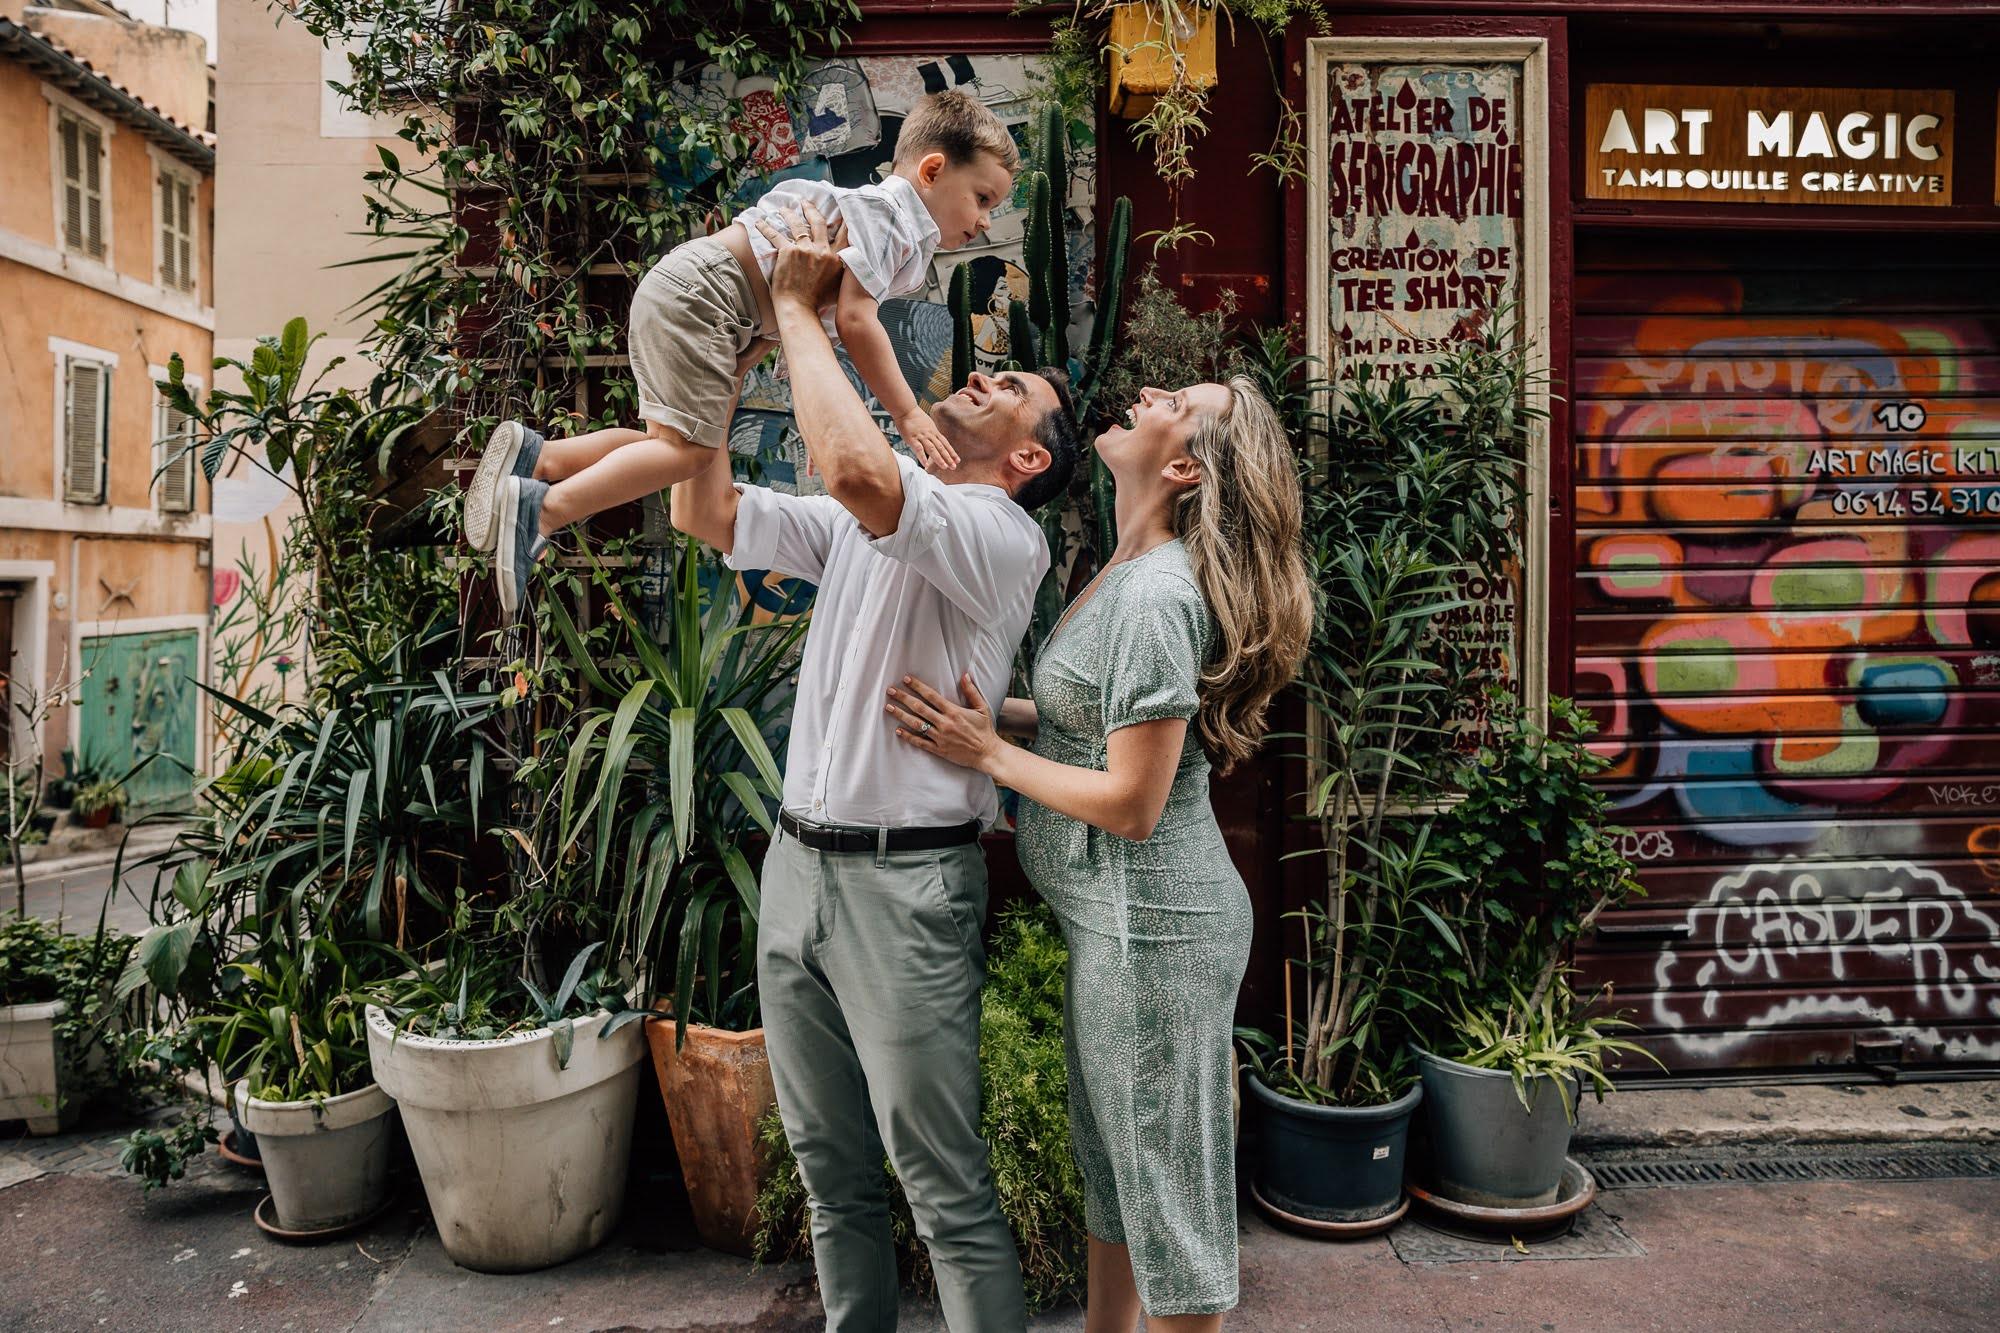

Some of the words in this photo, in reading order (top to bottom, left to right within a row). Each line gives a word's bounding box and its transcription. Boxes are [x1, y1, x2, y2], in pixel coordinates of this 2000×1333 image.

[1468, 96, 1507, 134] DE
[1599, 107, 1713, 156] ART
[1746, 109, 1945, 162] MAGIC
[1331, 132, 1524, 219] SERIGRAPHIE
[1601, 168, 1790, 191] TAMBOUILLE
[1800, 169, 1945, 193] CRÉATIVE
[1477, 246, 1511, 271] DE
[1337, 277, 1394, 313] TEE
[1875, 402, 1927, 432] 10
[1807, 449, 1864, 475] ART
[1867, 448, 1948, 476] MAGIC
